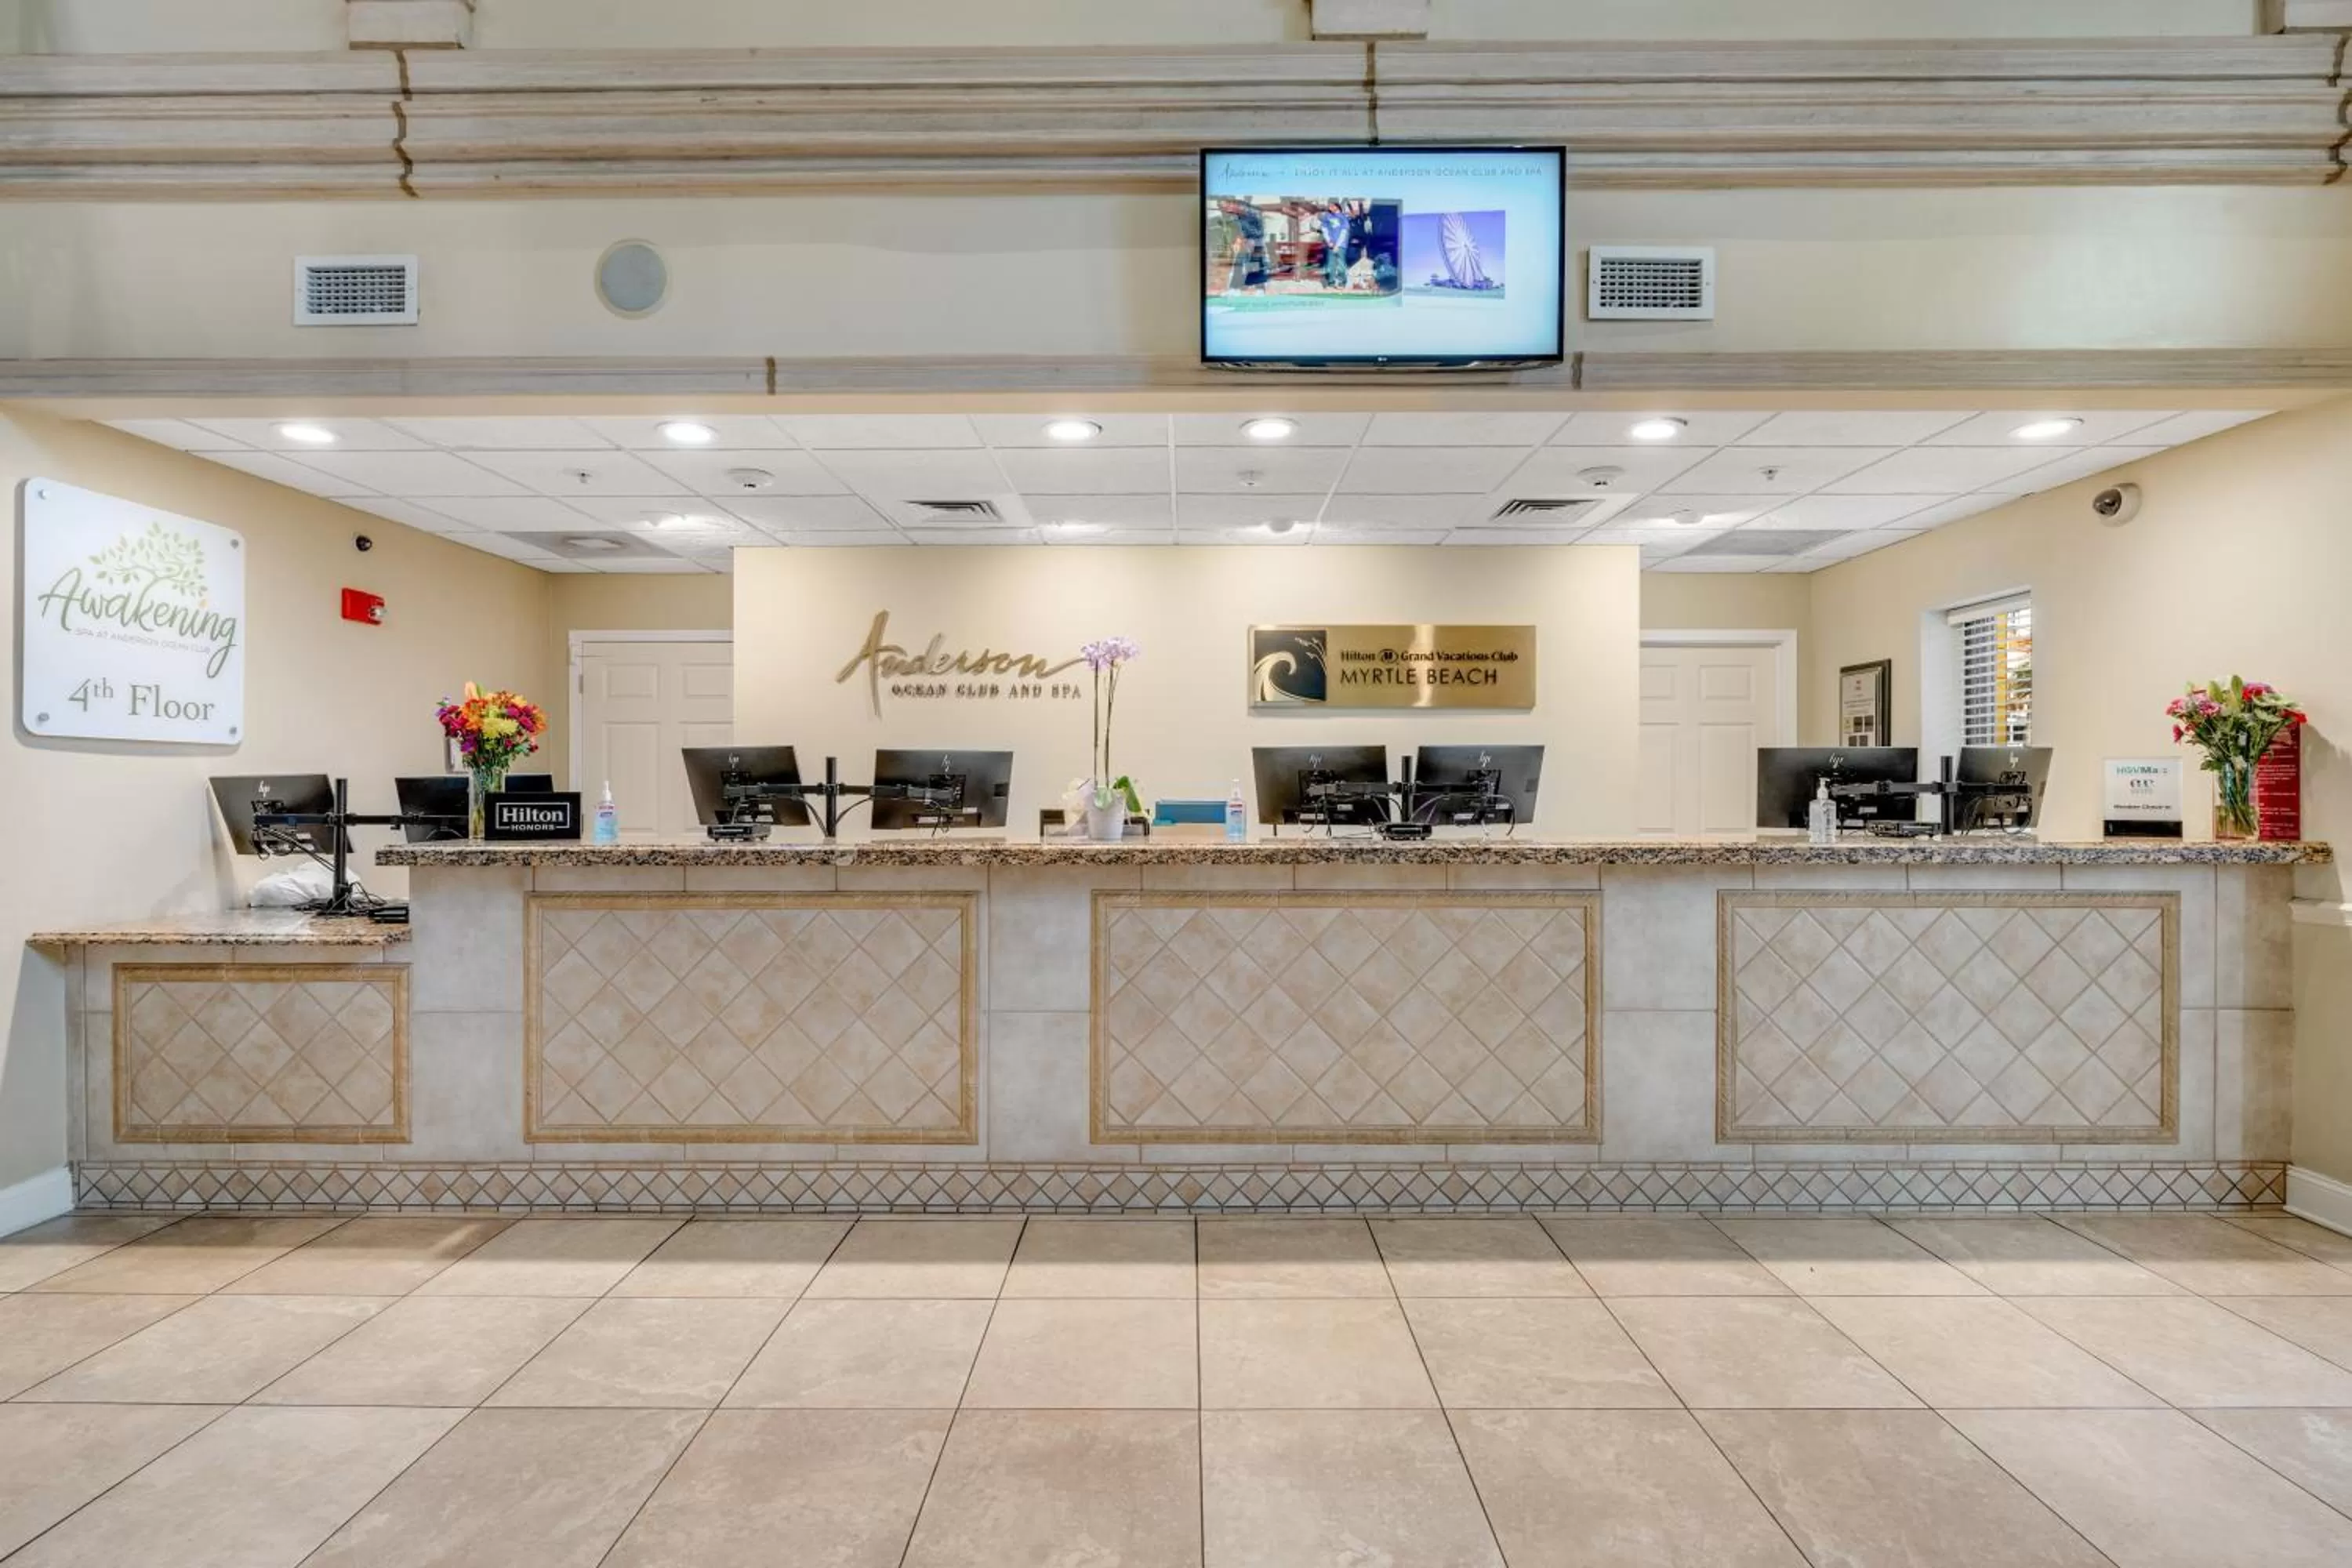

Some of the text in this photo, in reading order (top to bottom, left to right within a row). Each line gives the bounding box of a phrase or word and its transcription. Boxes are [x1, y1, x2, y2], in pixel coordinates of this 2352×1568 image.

[38, 567, 238, 679] Awakening
[835, 609, 1090, 719] Anderson
[1340, 650, 1376, 662] Hilton
[1400, 650, 1434, 662] Grand
[1436, 650, 1490, 662] Vacations
[1490, 650, 1519, 662] Club
[1340, 667, 1498, 685] MYRTLE BEACH
[68, 677, 216, 720] 4th Floor
[891, 683, 1082, 698] OCEAN CLUB AND SPA
[502, 807, 564, 822] Hilton
